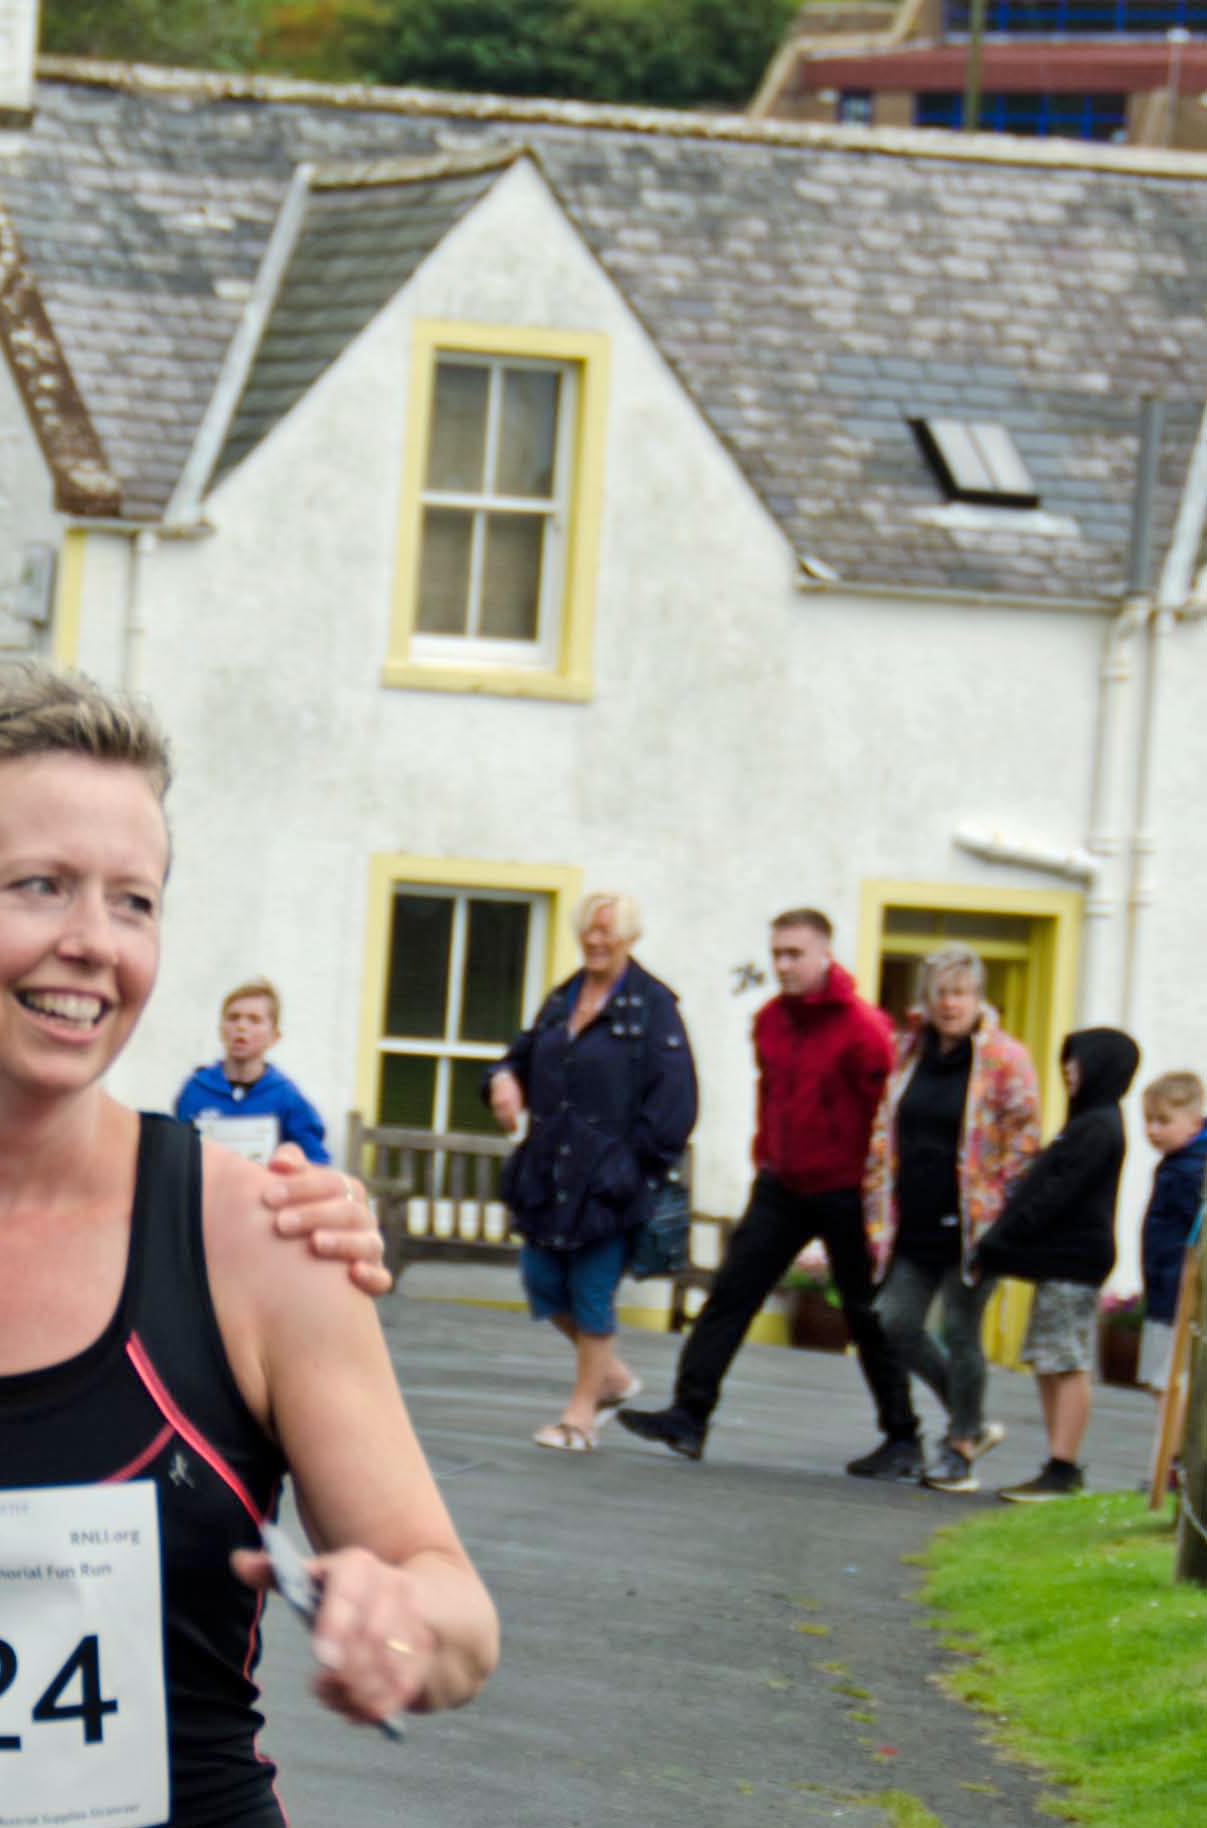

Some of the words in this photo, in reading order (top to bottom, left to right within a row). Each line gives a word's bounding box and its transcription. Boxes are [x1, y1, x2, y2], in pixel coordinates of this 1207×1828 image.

[69, 1528, 141, 1545] RNLI.org
[46, 1563, 76, 1579] Fun
[80, 1561, 112, 1577] Run
